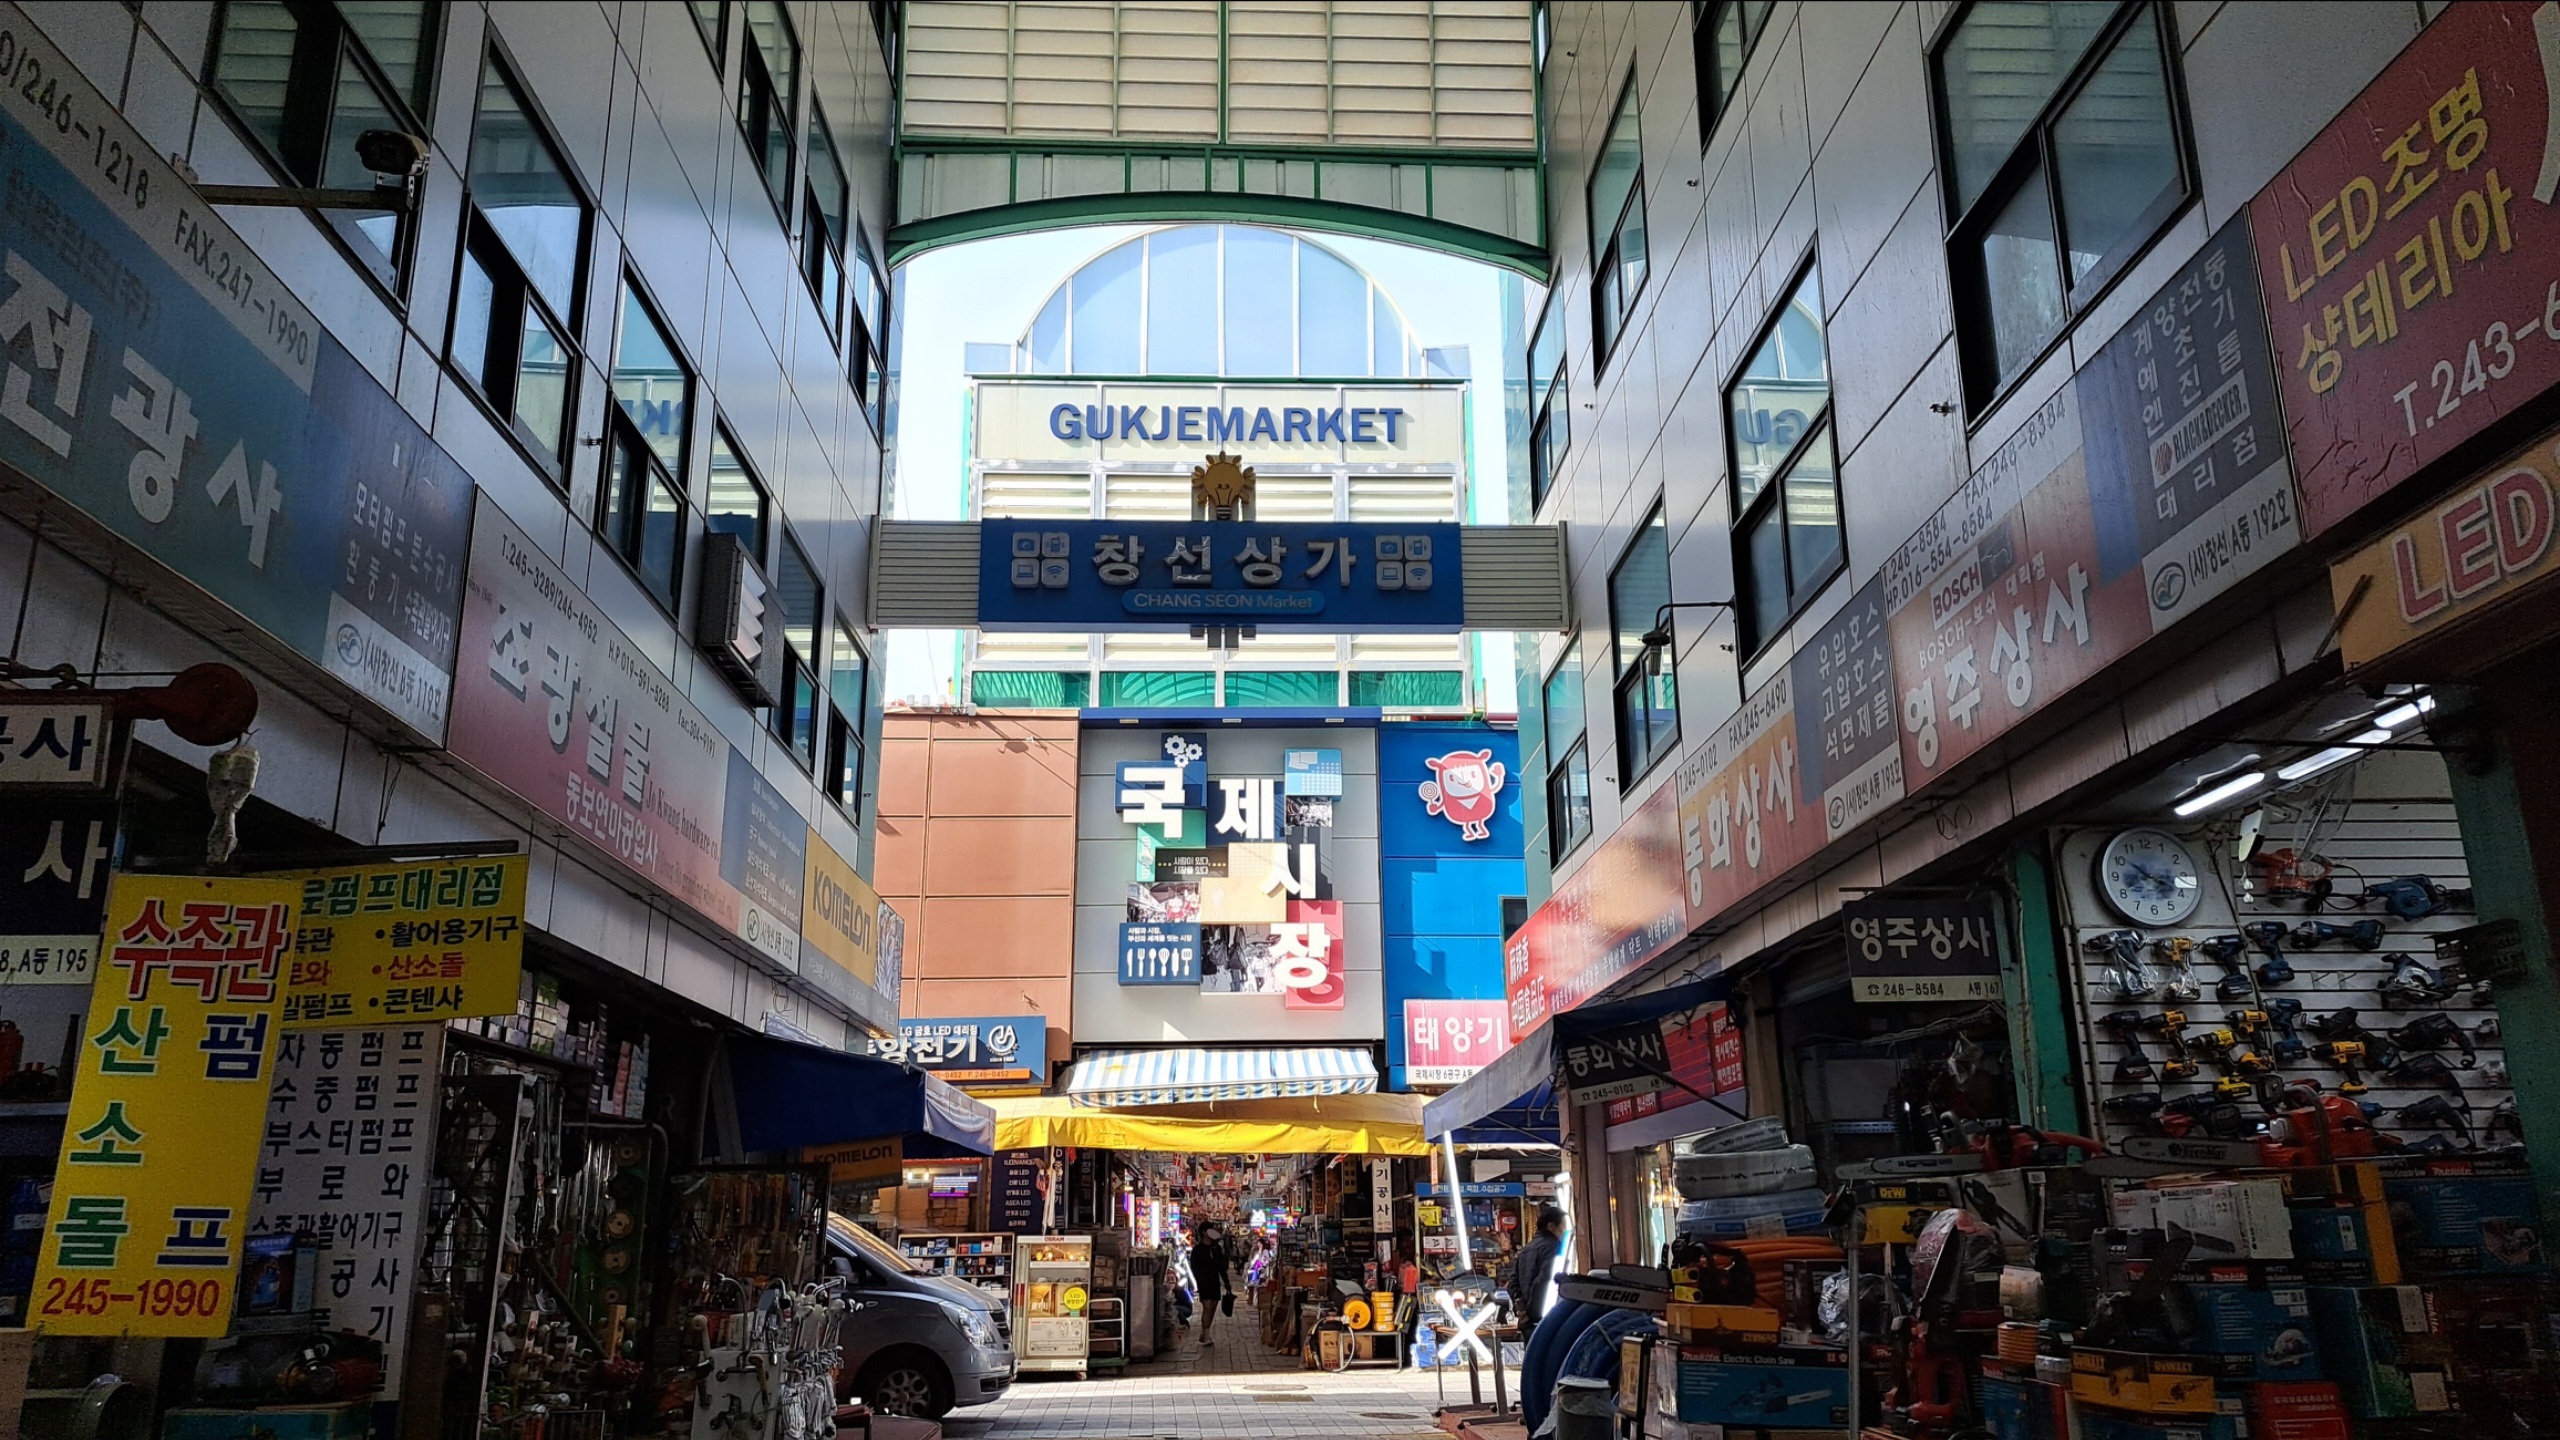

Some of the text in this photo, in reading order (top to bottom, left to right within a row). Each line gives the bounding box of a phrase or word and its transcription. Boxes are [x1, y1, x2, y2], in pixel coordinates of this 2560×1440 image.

[175, 208, 309, 366] FAX.247-1990
[1049, 402, 1403, 444] GUKJEMARKET
[2155, 425, 2257, 520] 대리점
[352, 481, 408, 560] 모터펌프
[2187, 486, 2291, 588] (사)창선 A동 192호
[1092, 534, 1357, 588] 창선상가
[1882, 510, 1947, 588] T.248-8584
[2392, 467, 2555, 623] LED
[346, 538, 400, 617] 환풍기
[502, 534, 598, 645] T.245-3289/246-4952
[1933, 560, 1980, 621] BOSCH
[2005, 551, 2047, 598] 대리점
[1133, 590, 1314, 610] CHANG SEON Market
[1819, 600, 1881, 681] 유압호스
[363, 631, 399, 694] (사)창선
[1904, 561, 2088, 769] 영주상사
[1822, 645, 1885, 723] 고압호스
[1826, 688, 1891, 762] 석면제품
[1679, 744, 1718, 797] T.245-0102
[1684, 736, 1796, 908] 동화상사
[2114, 856, 2125, 867] 10
[2124, 843, 2134, 854] 11
[2138, 839, 2151, 850] 12
[2159, 842, 2165, 853] 1
[2173, 854, 2180, 865] 2
[2111, 871, 2119, 882] 9
[2119, 888, 2128, 899] 8
[2177, 888, 2185, 898] 4
[813, 866, 871, 956] KOMELON
[2134, 900, 2141, 911] 7
[2150, 905, 2158, 916] 6
[2167, 900, 2175, 911] 5
[112, 899, 290, 1002] 수족관
[390, 915, 519, 949] 활어용기구
[1850, 916, 1991, 962] 영주상사
[57, 948, 88, 973] 195
[387, 951, 466, 981] 산소돌
[1884, 982, 1944, 997] 248-8584
[899, 1025, 977, 1036] LG 금호 LED 대리점
[1414, 1017, 1504, 1053] 태양기
[1415, 1069, 1441, 1081] 국제시장
[1593, 1083, 1634, 1100] 245-0102
[266, 1119, 413, 1159] 부스터펌프
[41, 1277, 221, 1319] 245-1990
[1602, 1289, 1640, 1304] ECHO
[1723, 1353, 1752, 1363] Electric
[1754, 1355, 1776, 1365] Chain
[1778, 1355, 1796, 1366] Saw
